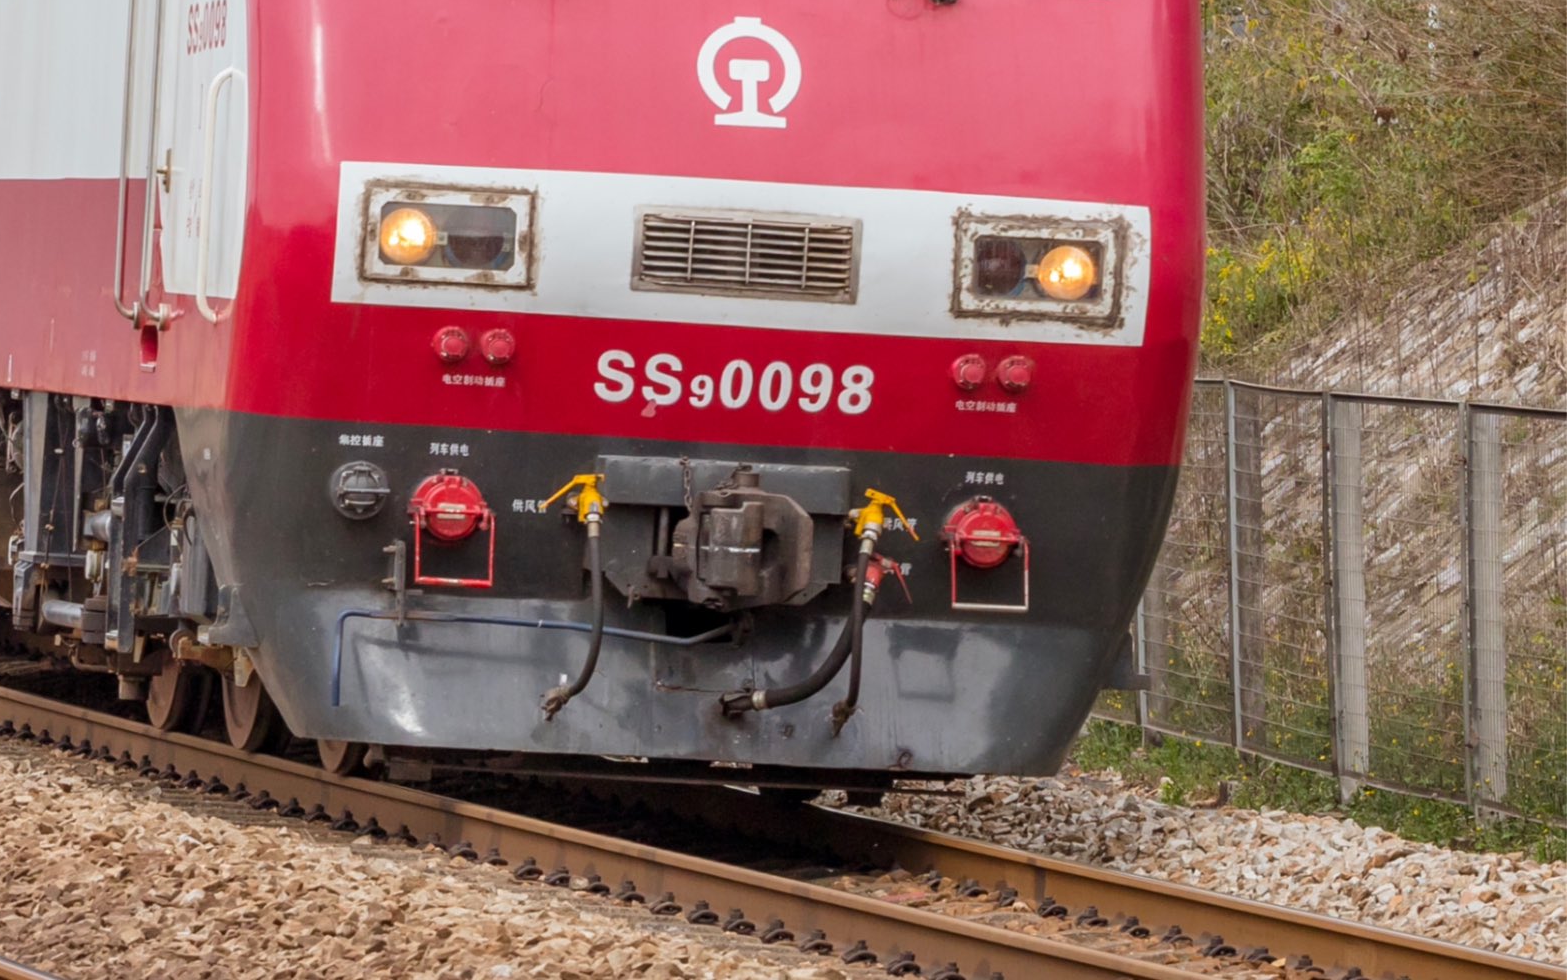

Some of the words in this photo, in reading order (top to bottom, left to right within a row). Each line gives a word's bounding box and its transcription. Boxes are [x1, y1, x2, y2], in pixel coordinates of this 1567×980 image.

[429, 442, 470, 457] 列车供电
[964, 470, 1005, 485] 列车供电
